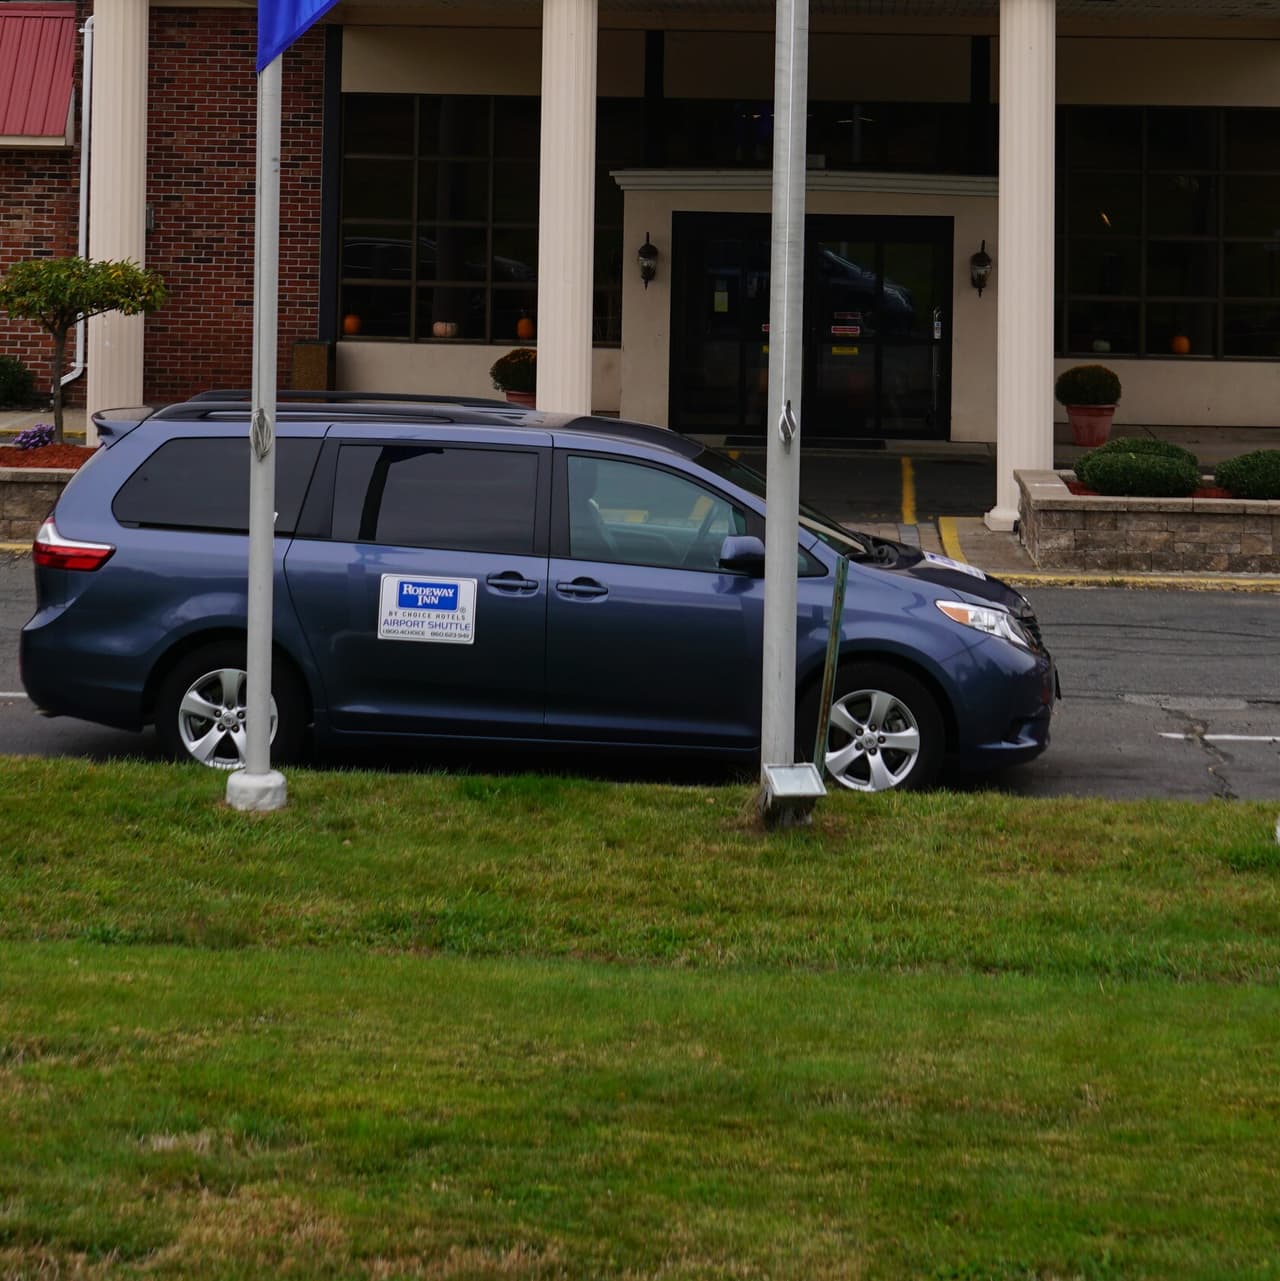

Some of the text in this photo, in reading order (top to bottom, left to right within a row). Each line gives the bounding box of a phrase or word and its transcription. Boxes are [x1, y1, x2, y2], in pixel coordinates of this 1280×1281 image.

[402, 583, 455, 597] RODEWAY
[417, 595, 439, 606] INN
[435, 613, 466, 621] HOTELS
[383, 619, 471, 631] AIRPORT SHUTTLE
